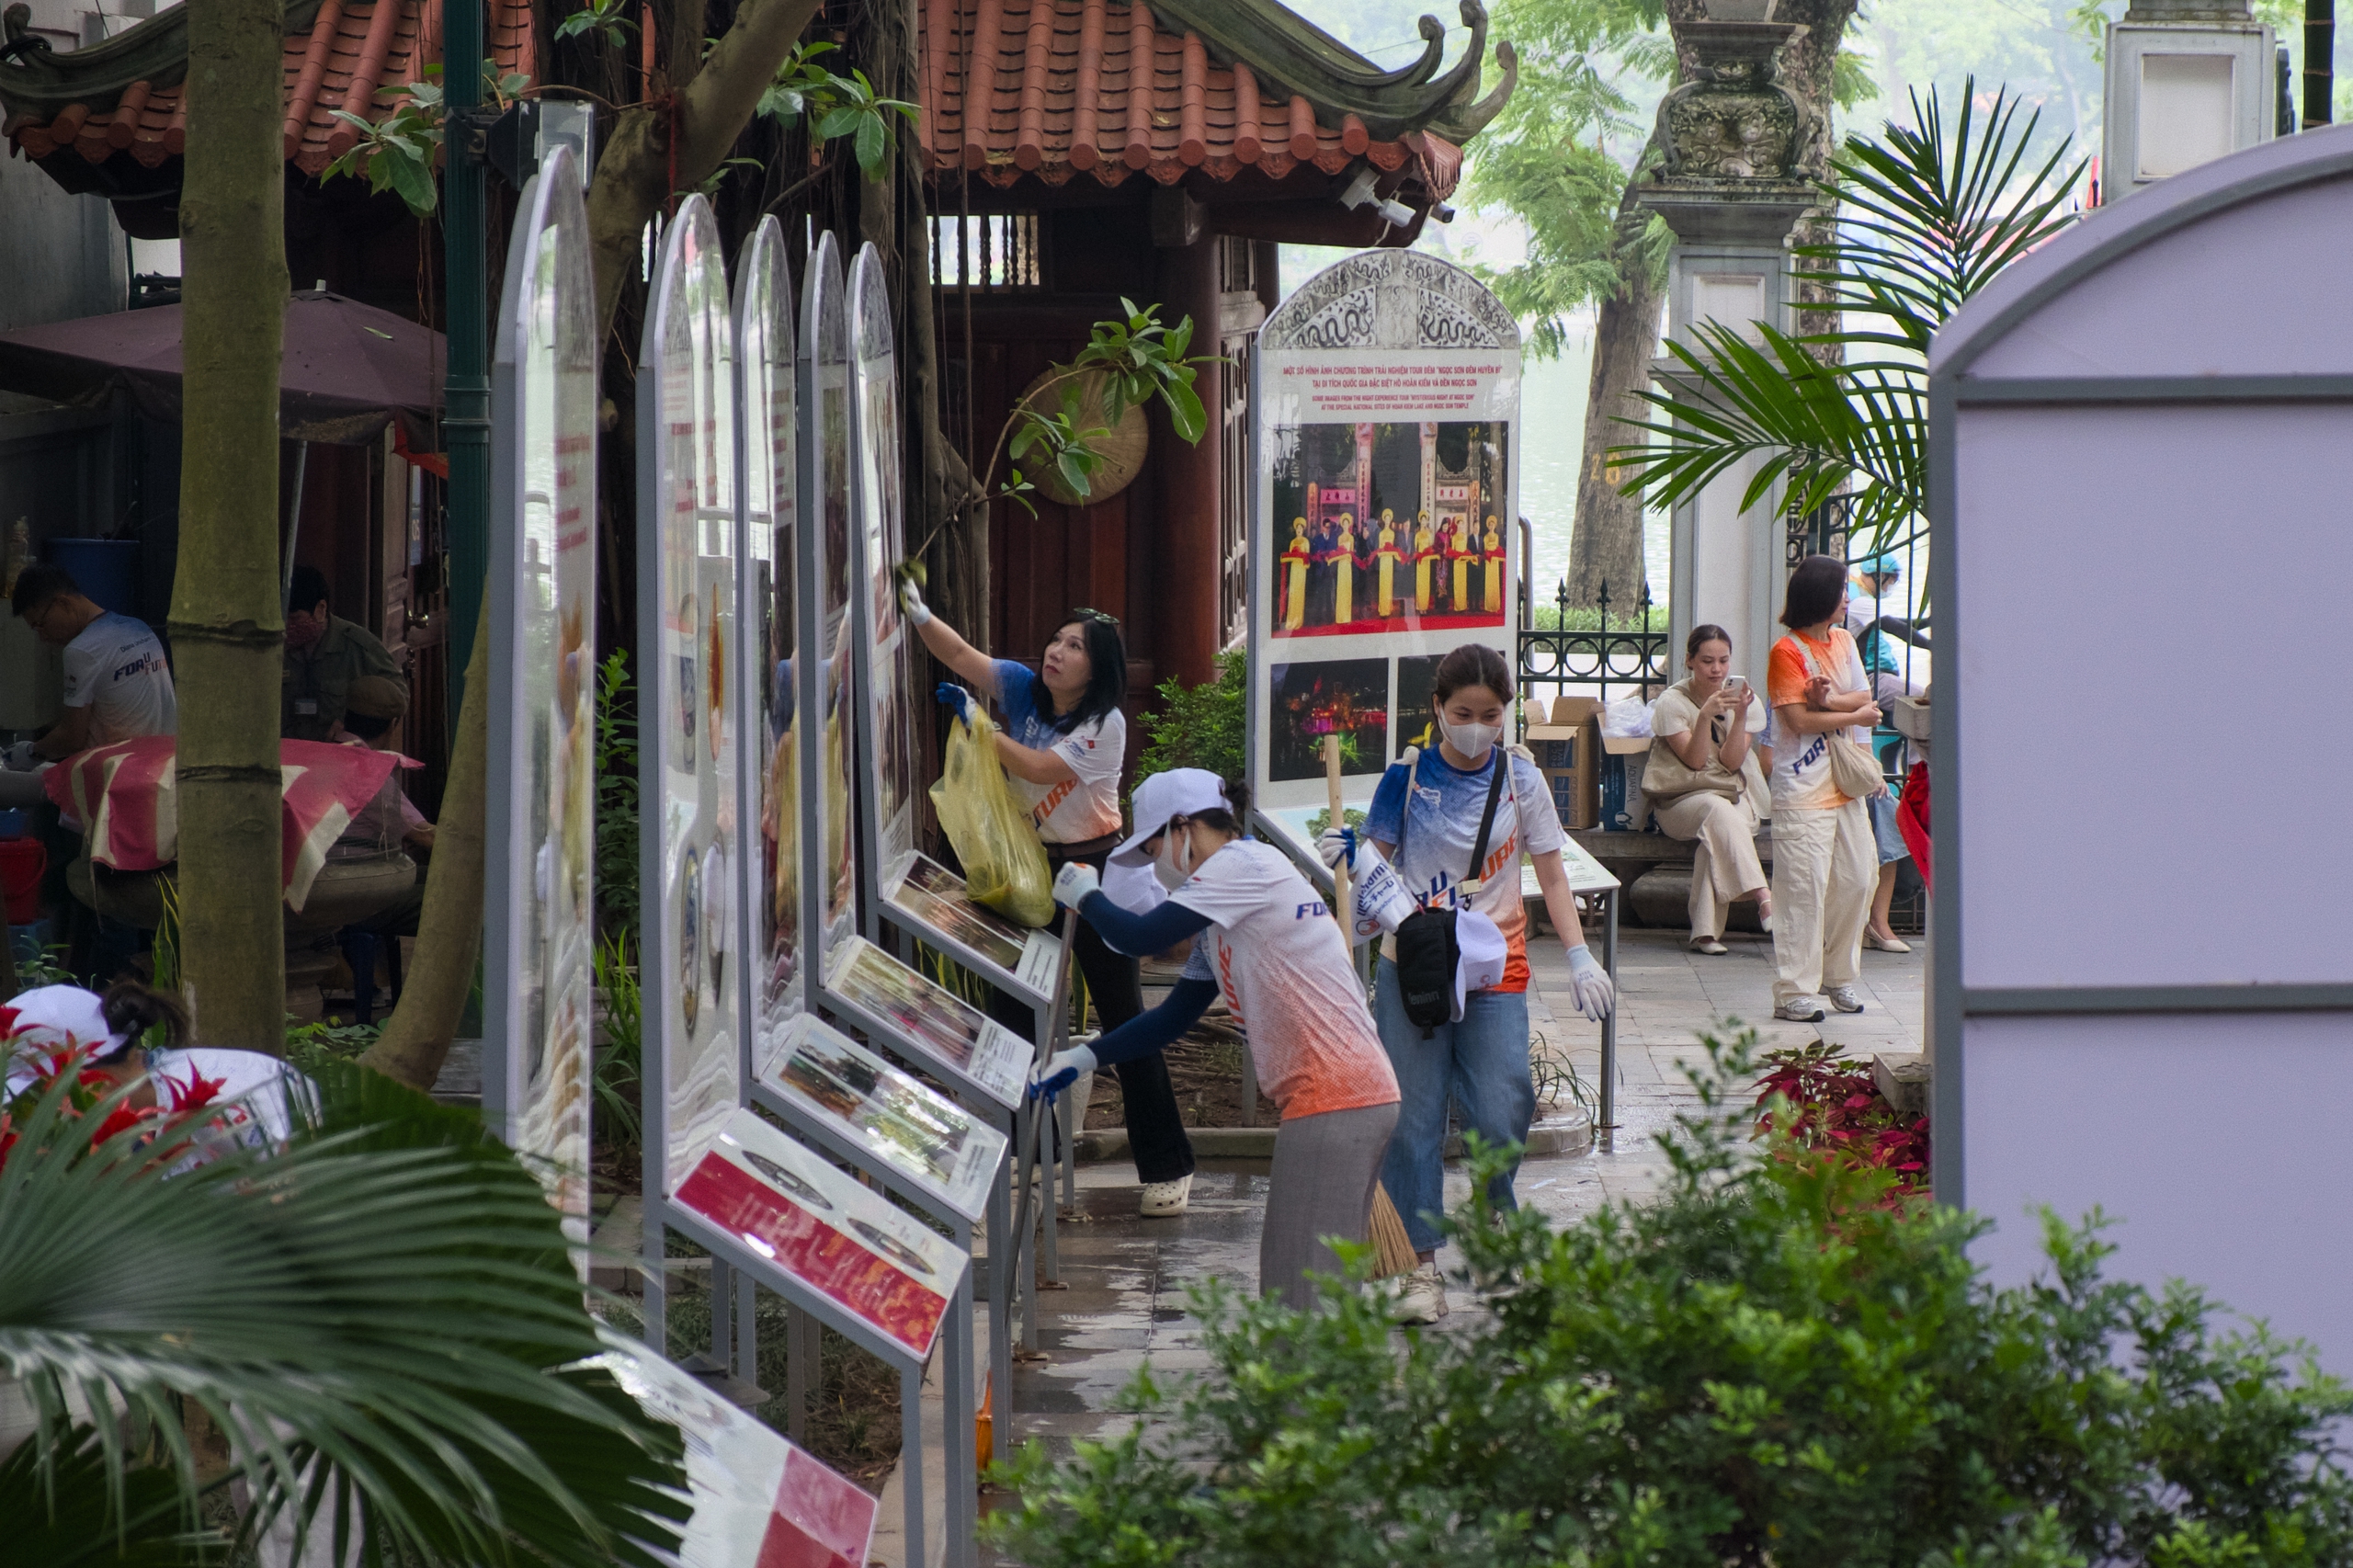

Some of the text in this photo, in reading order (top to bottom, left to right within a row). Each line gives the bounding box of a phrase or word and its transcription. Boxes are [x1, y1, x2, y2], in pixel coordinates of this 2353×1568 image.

[1305, 365, 1319, 375] HÌNH
[1358, 365, 1373, 375] TRÌNH
[1388, 365, 1408, 375] NGHIỆM
[1409, 366, 1422, 374] TOUR
[1329, 379, 1341, 387] TÍCH
[1343, 378, 1358, 388] QUỐC
[1381, 378, 1392, 388] BIỆT
[1403, 377, 1416, 387] HOÀN
[1432, 377, 1438, 386] VÀ
[1451, 379, 1465, 388] NGỌC
[1467, 378, 1477, 386] SƠN
[1792, 736, 1825, 775] FOR
[1627, 765, 1637, 802] AQUAFINA
